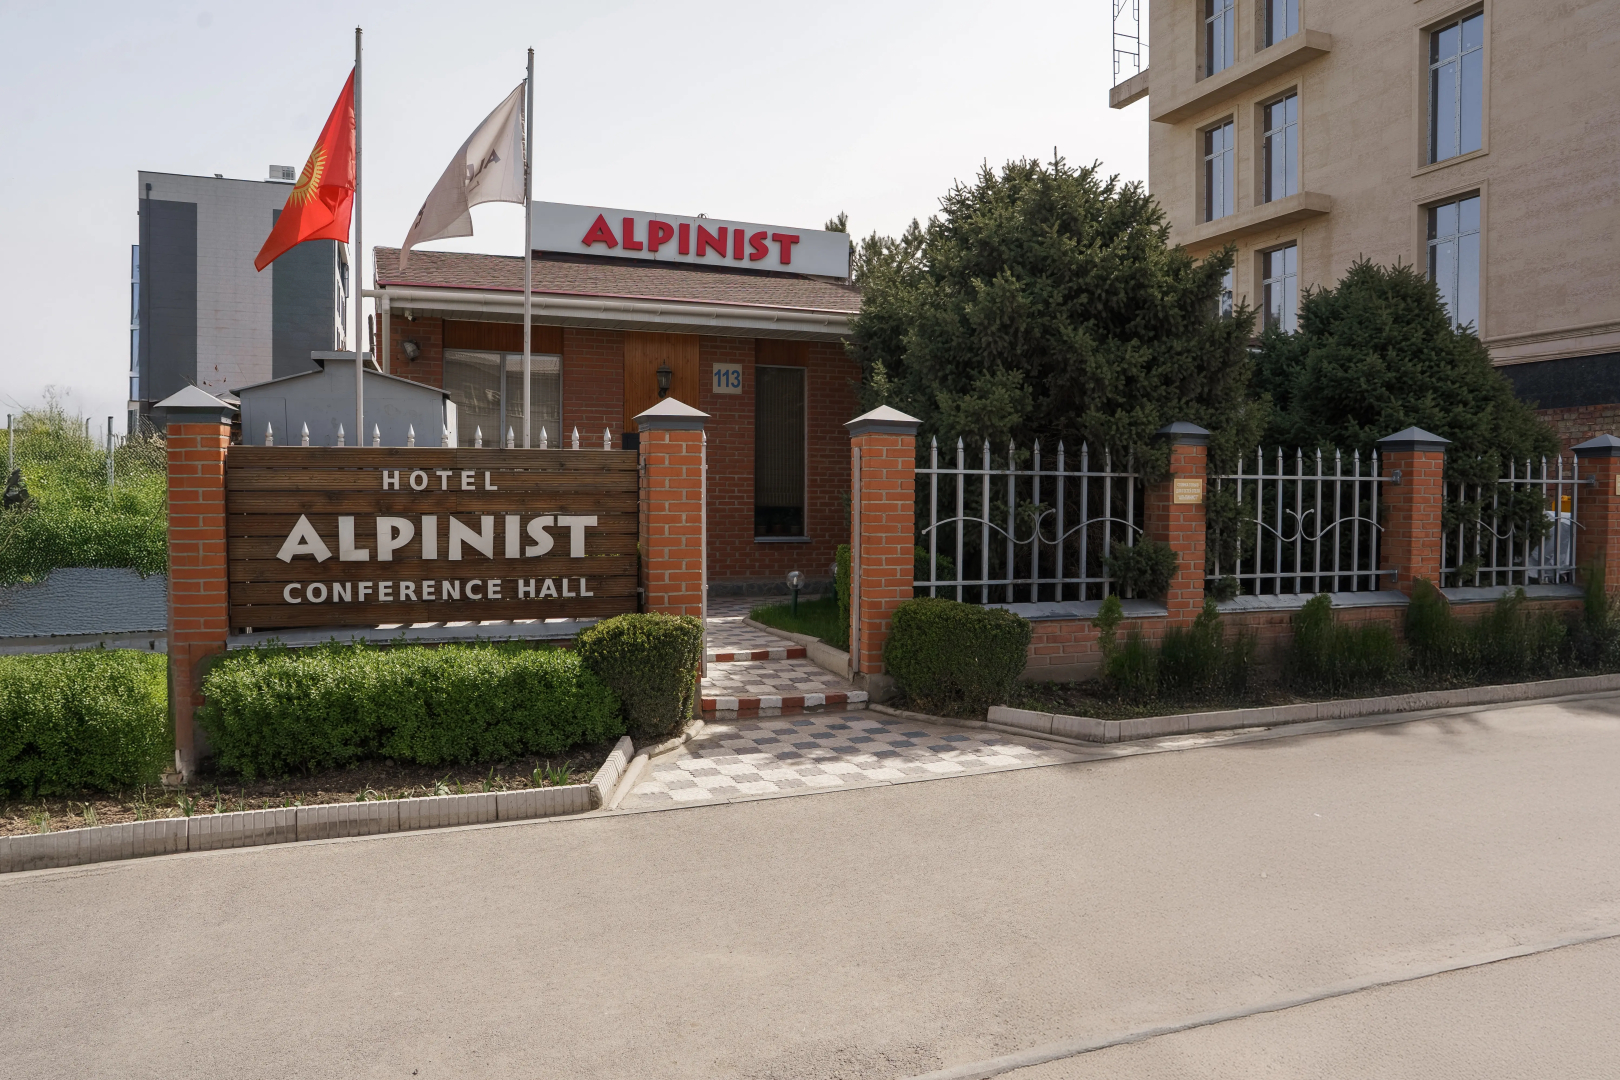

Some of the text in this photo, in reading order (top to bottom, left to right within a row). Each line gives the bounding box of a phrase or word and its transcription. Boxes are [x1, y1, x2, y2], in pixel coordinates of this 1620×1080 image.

[581, 213, 800, 265] ALPINIST
[714, 369, 741, 388] 113
[382, 470, 498, 491] HOTEL
[276, 513, 598, 563] ALPINIST
[283, 577, 594, 604] CONFERENCE HALL
